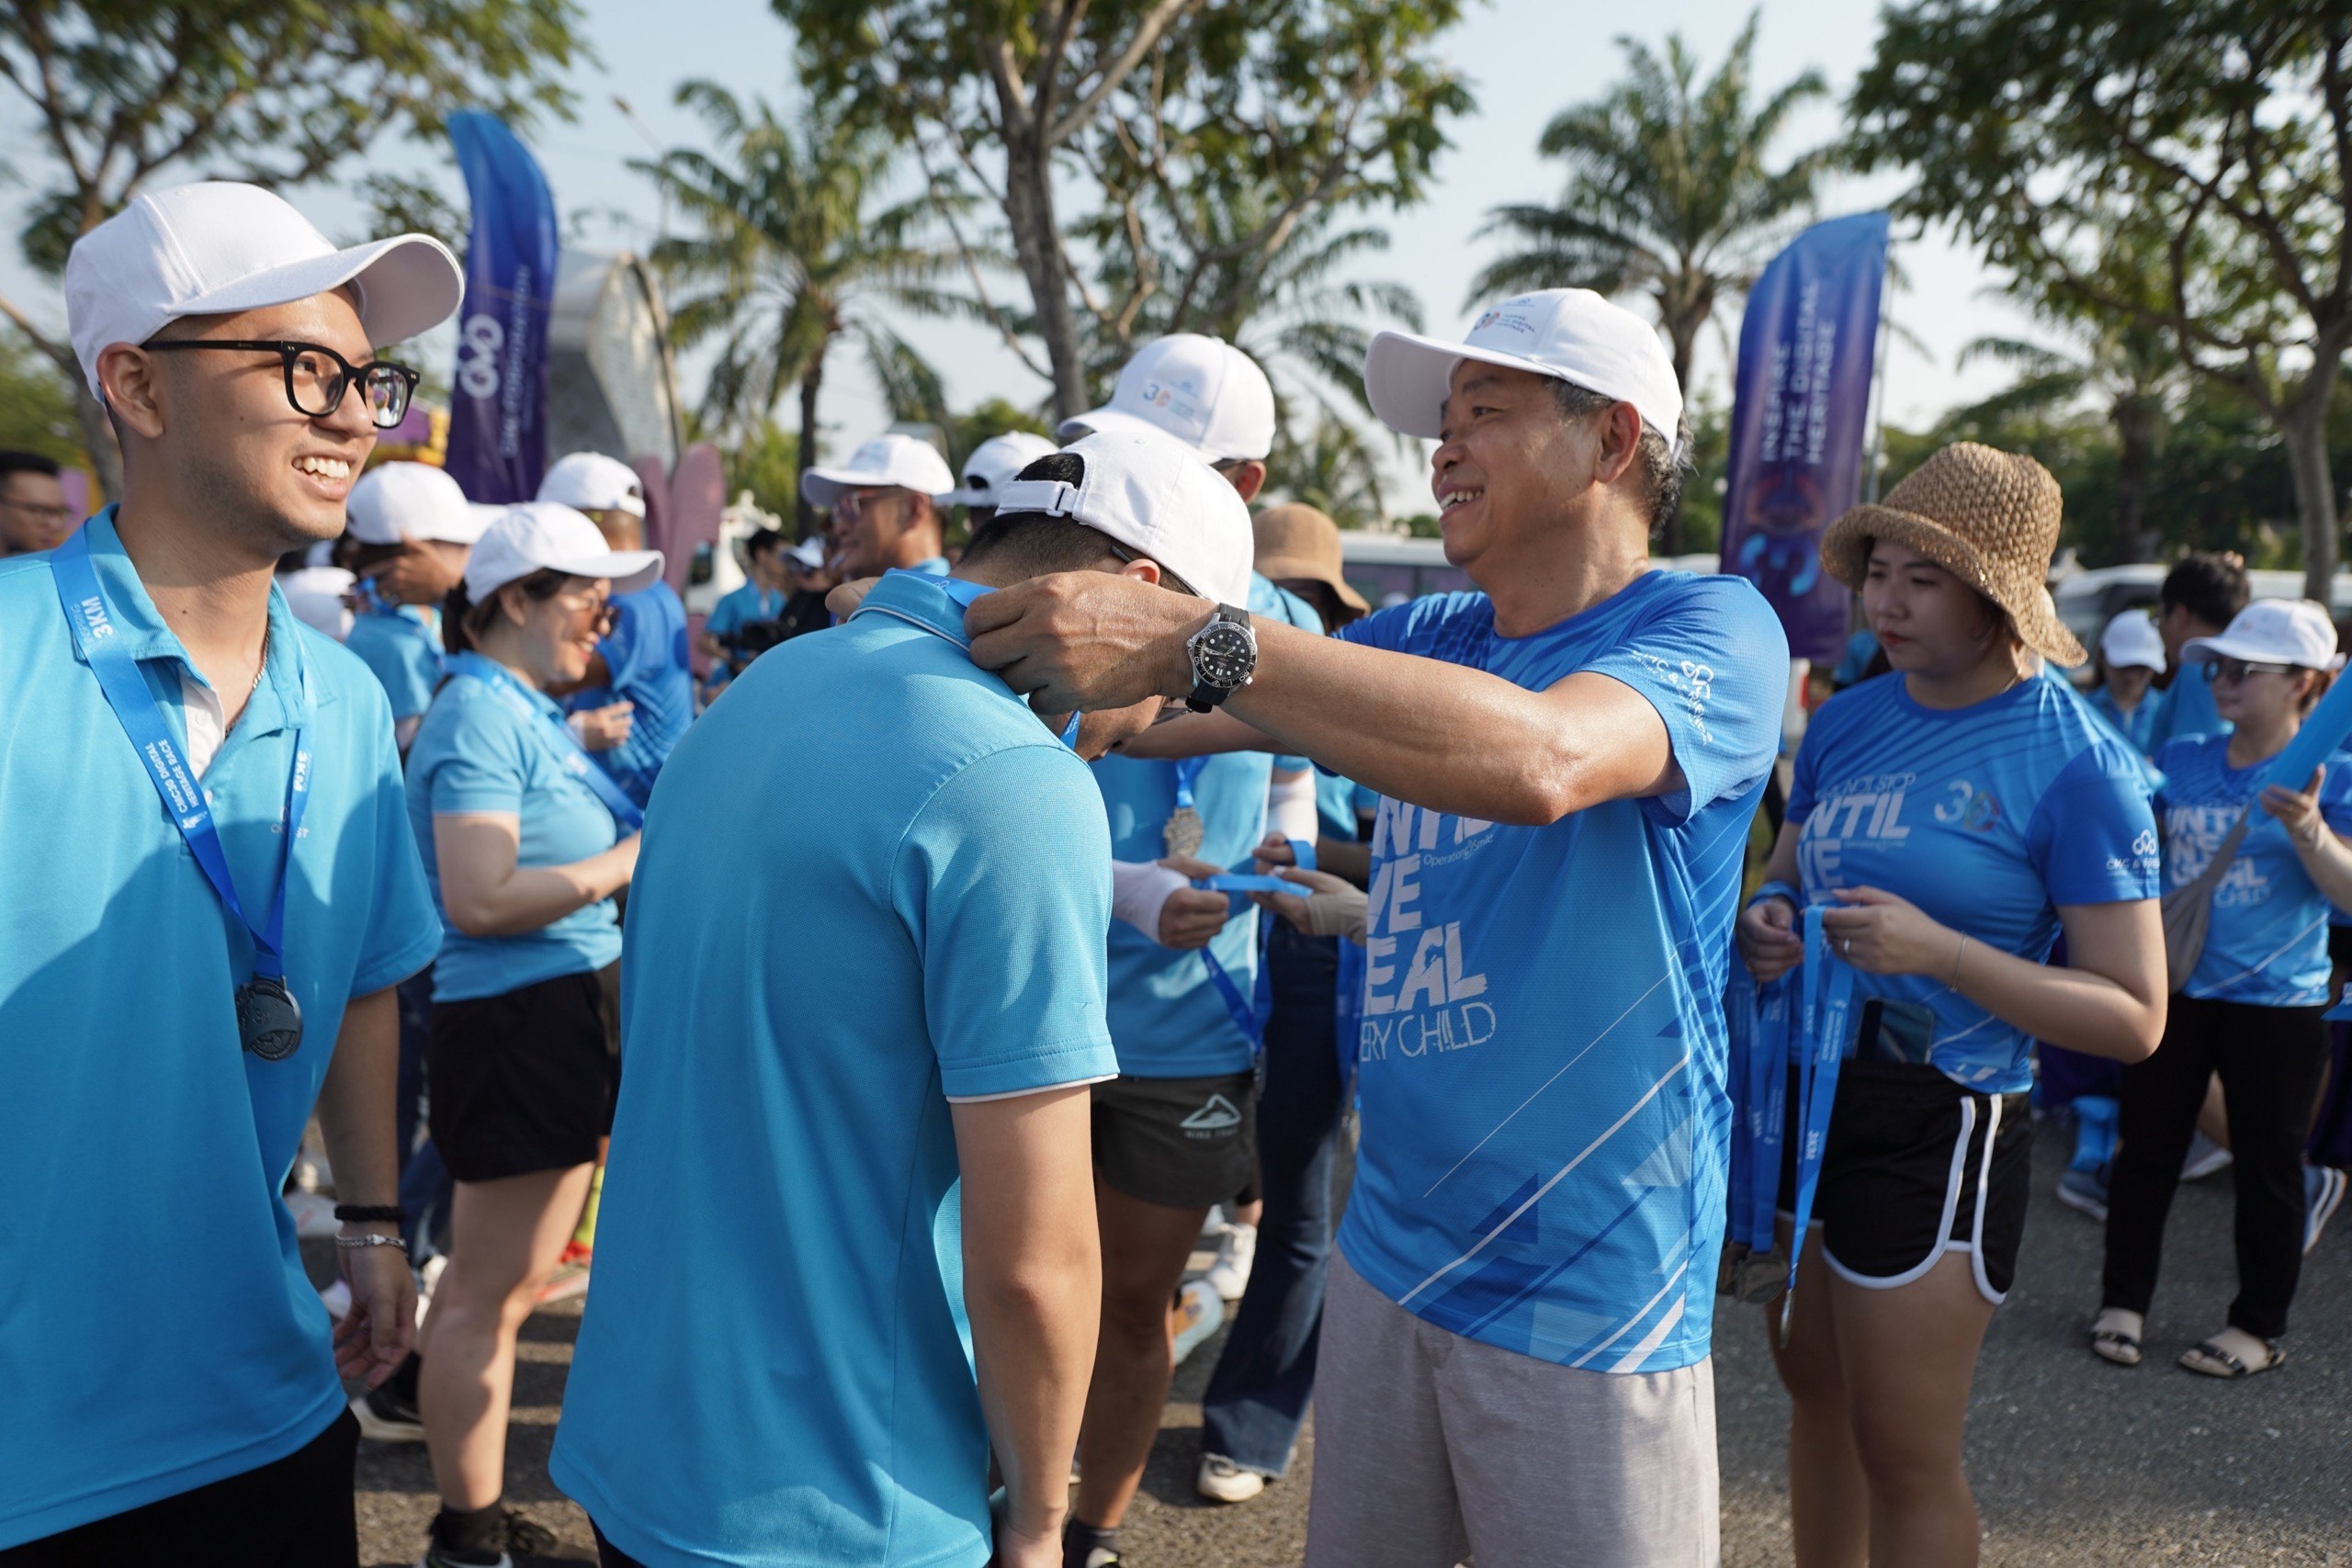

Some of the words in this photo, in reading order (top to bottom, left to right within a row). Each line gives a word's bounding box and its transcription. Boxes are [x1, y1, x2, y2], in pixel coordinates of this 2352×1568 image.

[1791, 281, 1819, 393] DIGITAL
[1761, 341, 1791, 462] INSPIRE
[1805, 318, 1837, 464] HERITAGE
[1782, 402, 1807, 457] THE
[81, 595, 114, 639] 3KM
[145, 741, 170, 779] DIGITAL
[158, 739, 177, 766] RACE
[293, 750, 309, 792] 3KM
[164, 779, 187, 813] CMC30
[172, 764, 199, 807] HERITAGE
[1802, 794, 1911, 842] NTIL
[1424, 847, 1468, 867] Operation
[1472, 833, 1494, 852] Smile
[1364, 920, 1488, 1017] EAL
[1360, 1019, 1393, 1062] ERY
[1397, 1001, 1497, 1057] CHILD
